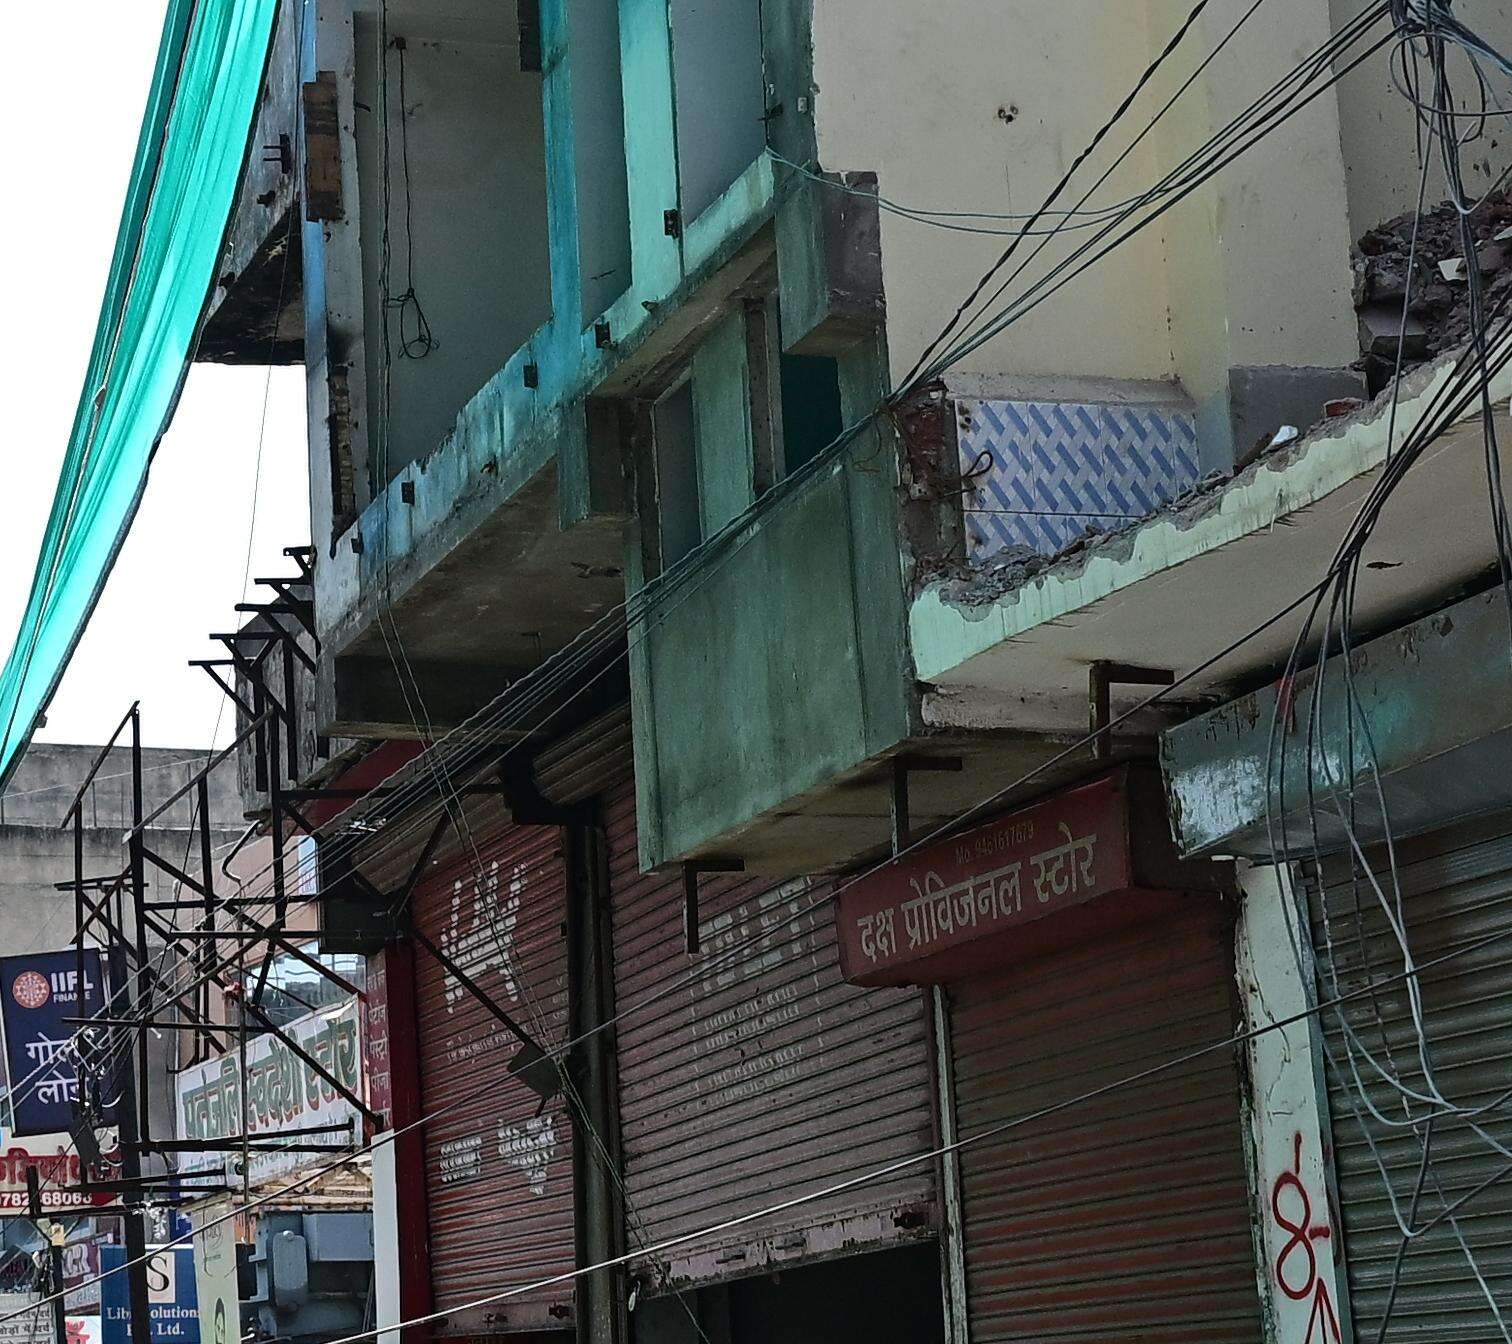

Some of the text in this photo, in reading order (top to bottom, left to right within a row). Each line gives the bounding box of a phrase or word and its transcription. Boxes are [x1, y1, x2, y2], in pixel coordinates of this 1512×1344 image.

[857, 907, 897, 963] दक्ष
[901, 862, 1023, 952] प्रोविजनल
[1029, 821, 1098, 905] स्टोर
[51, 970, 94, 993] IIFL
[53, 991, 91, 1004] FINANE
[157, 1322, 185, 1336] Ltd.
